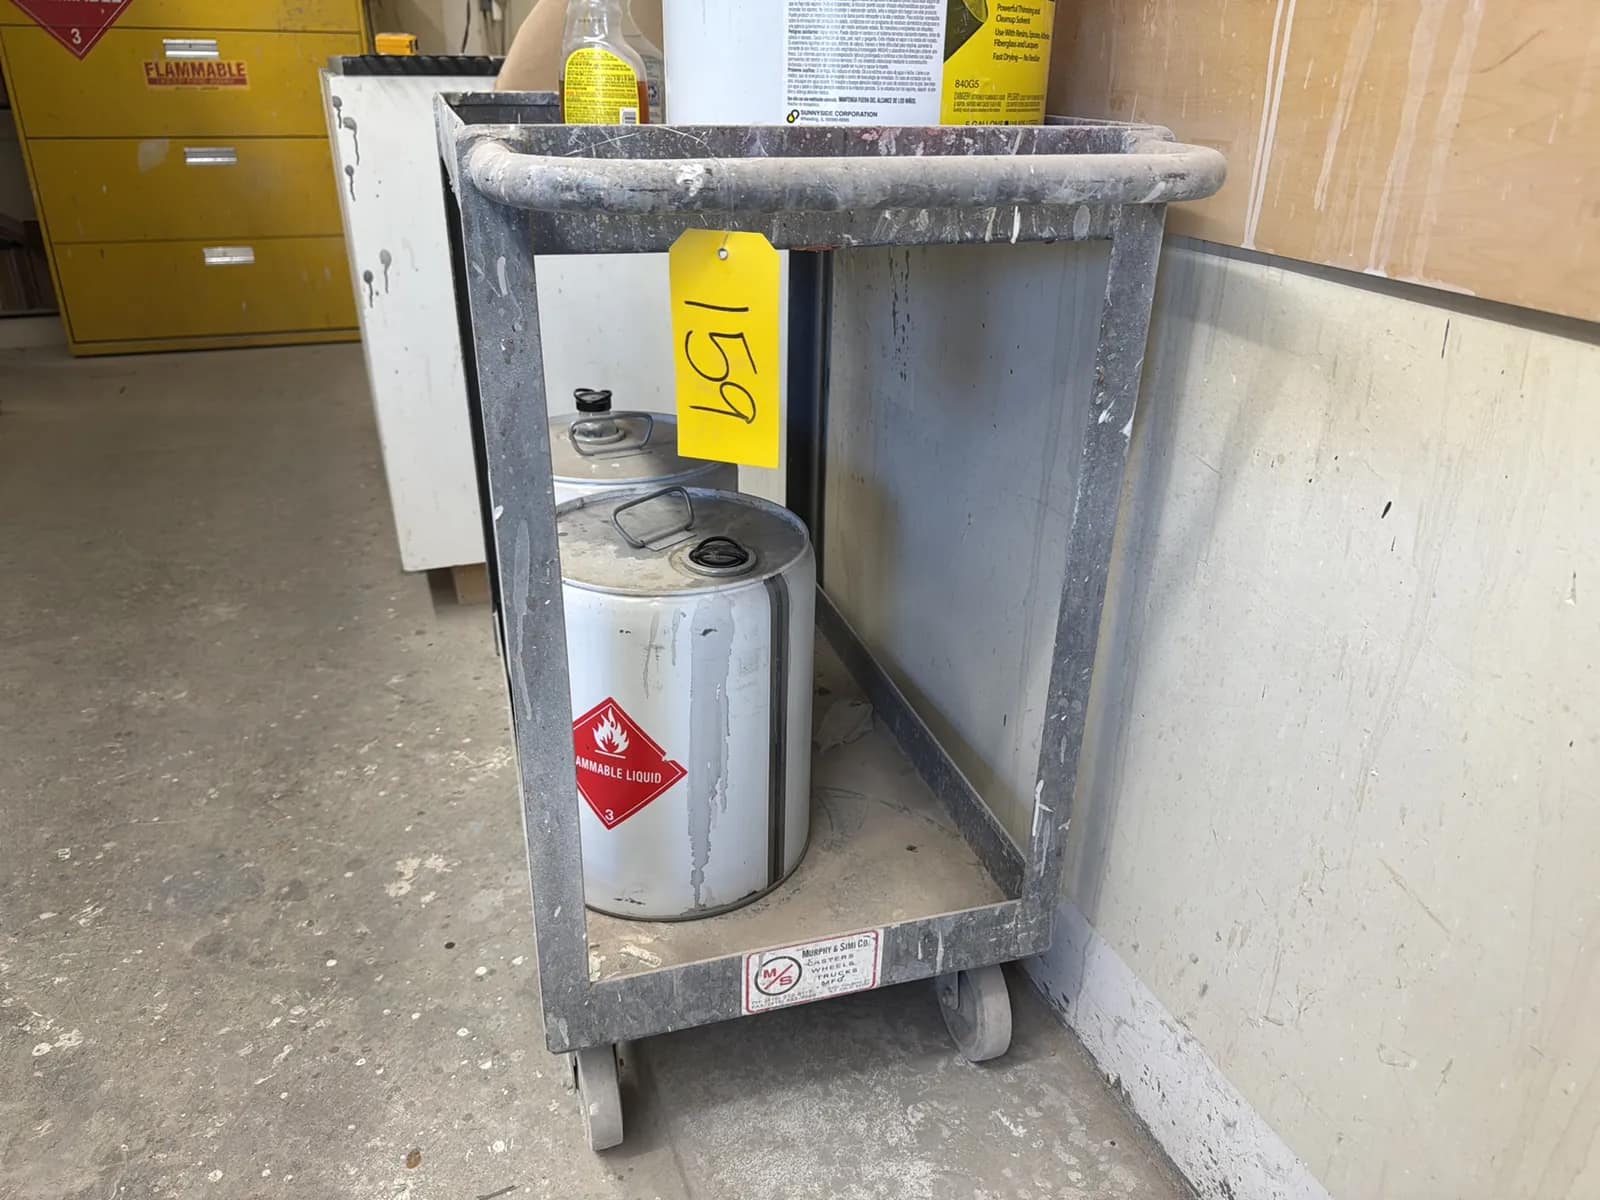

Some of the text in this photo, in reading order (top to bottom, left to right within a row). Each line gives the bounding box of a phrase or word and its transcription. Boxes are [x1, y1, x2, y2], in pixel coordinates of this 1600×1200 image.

[996, 14, 1016, 24] Cleanup
[70, 27, 82, 44] 3
[995, 28, 1004, 36] Use
[1005, 28, 1015, 36] With
[993, 52, 1003, 61] Fast
[1003, 53, 1018, 63] Drying
[143, 61, 246, 78] FLAMMABLE
[954, 79, 980, 88] 840G5
[684, 300, 758, 425] 159
[576, 755, 662, 784] AMMABLE LIQUID
[604, 808, 615, 821] 3
[833, 945, 839, 953] &
[808, 953, 855, 966] CASTERS
[811, 961, 856, 974] WHEELS
[817, 967, 858, 980] TRUCKS
